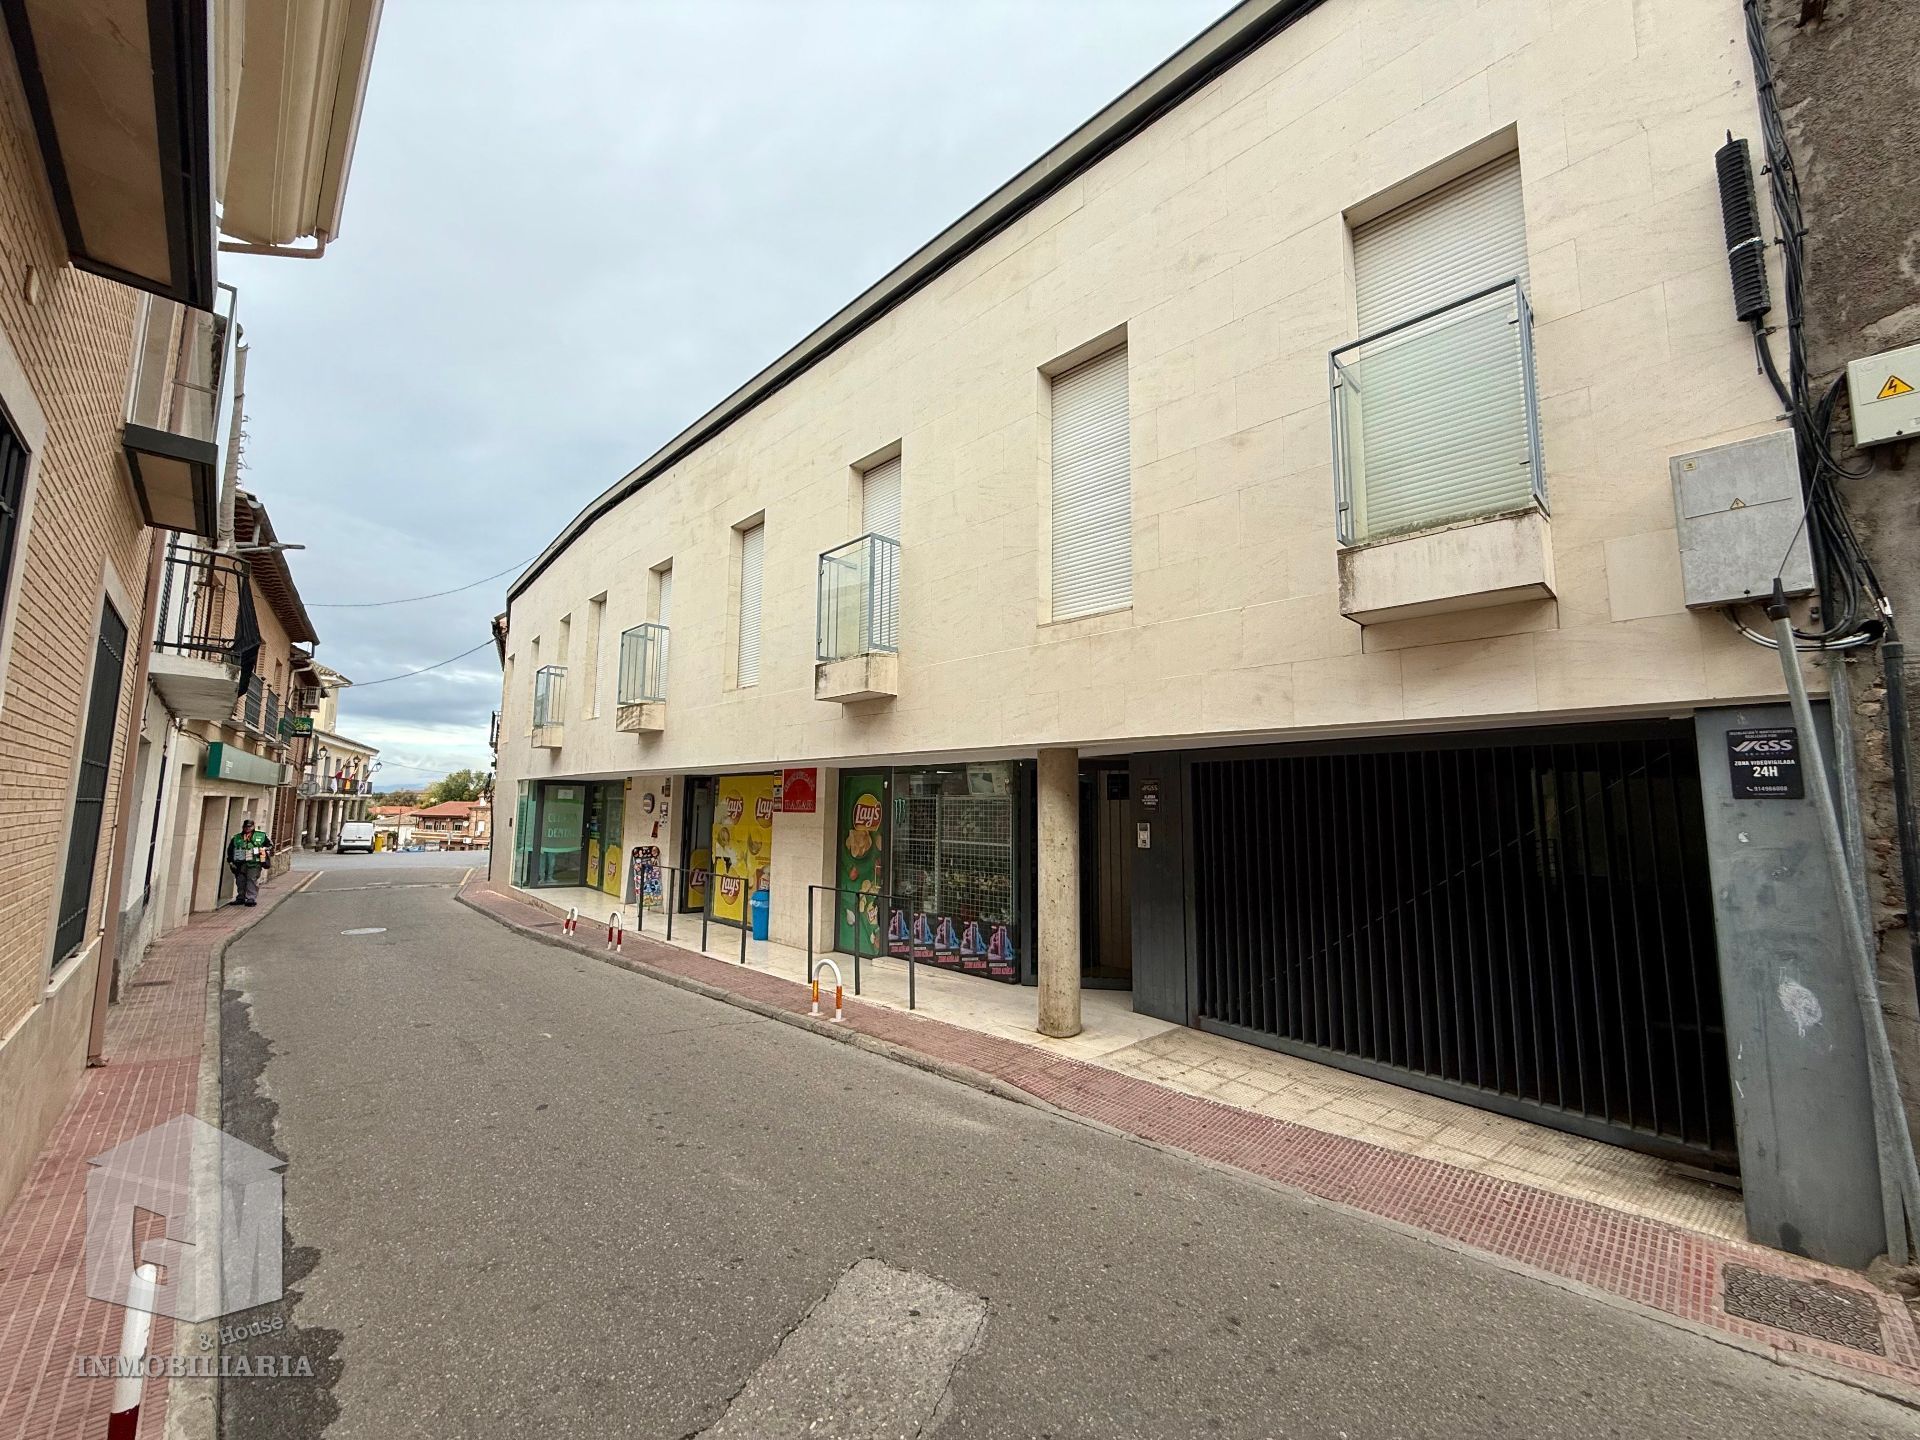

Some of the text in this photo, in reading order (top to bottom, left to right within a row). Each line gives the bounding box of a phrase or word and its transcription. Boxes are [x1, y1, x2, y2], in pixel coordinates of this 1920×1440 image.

[1754, 739, 1792, 751] GSS
[1752, 766, 1778, 777] 24H
[855, 804, 880, 828] Lay's
